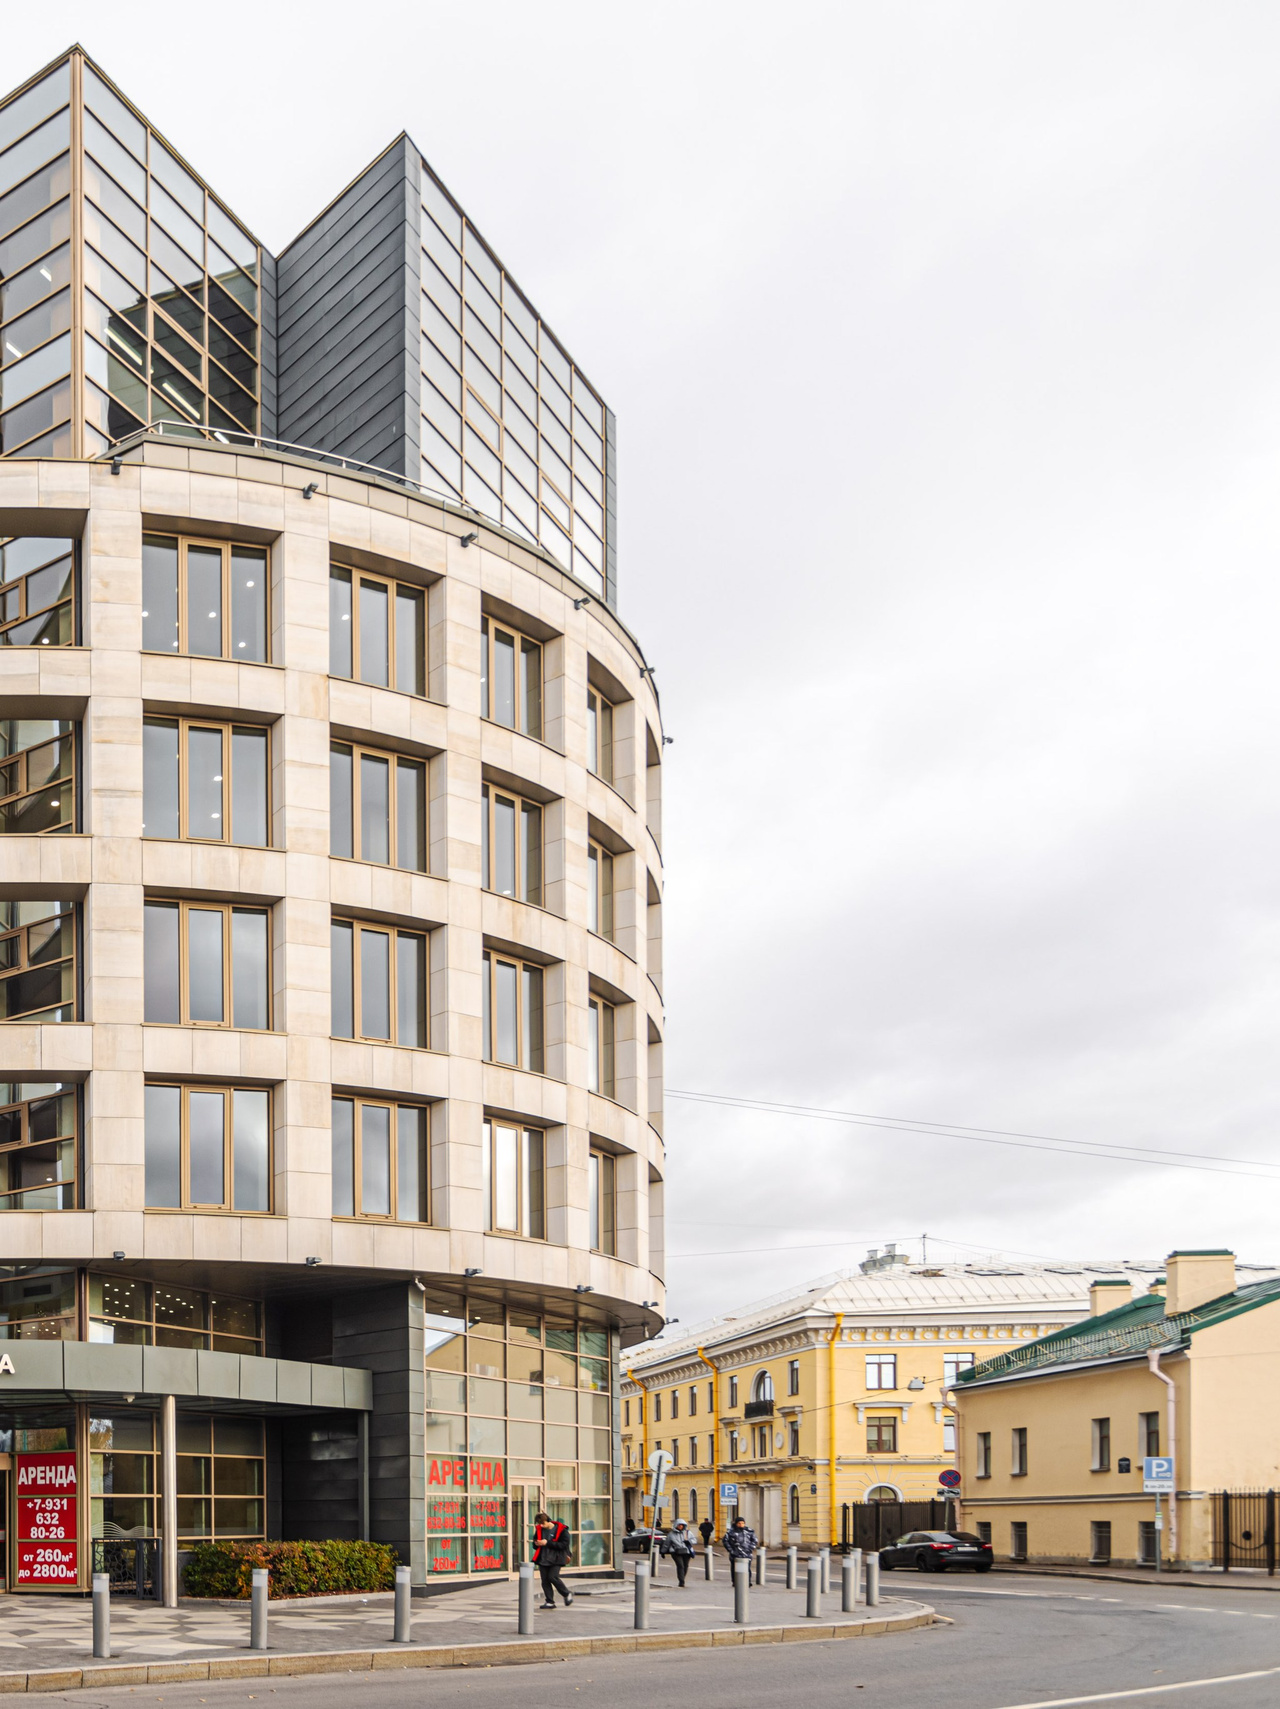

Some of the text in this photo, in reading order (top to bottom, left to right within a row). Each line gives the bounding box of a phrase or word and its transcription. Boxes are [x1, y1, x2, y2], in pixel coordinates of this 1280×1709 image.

[428, 1460, 505, 1490] АРЕНДА
[1152, 1460, 1168, 1477] P
[18, 1465, 76, 1487] АРЕНДА
[27, 1498, 68, 1511] +7-931
[36, 1512, 59, 1525] 632
[30, 1526, 65, 1539] 80-26
[441, 1539, 451, 1550] от
[483, 1539, 494, 1550] до
[23, 1554, 34, 1562] от
[18, 1569, 31, 1578] до
